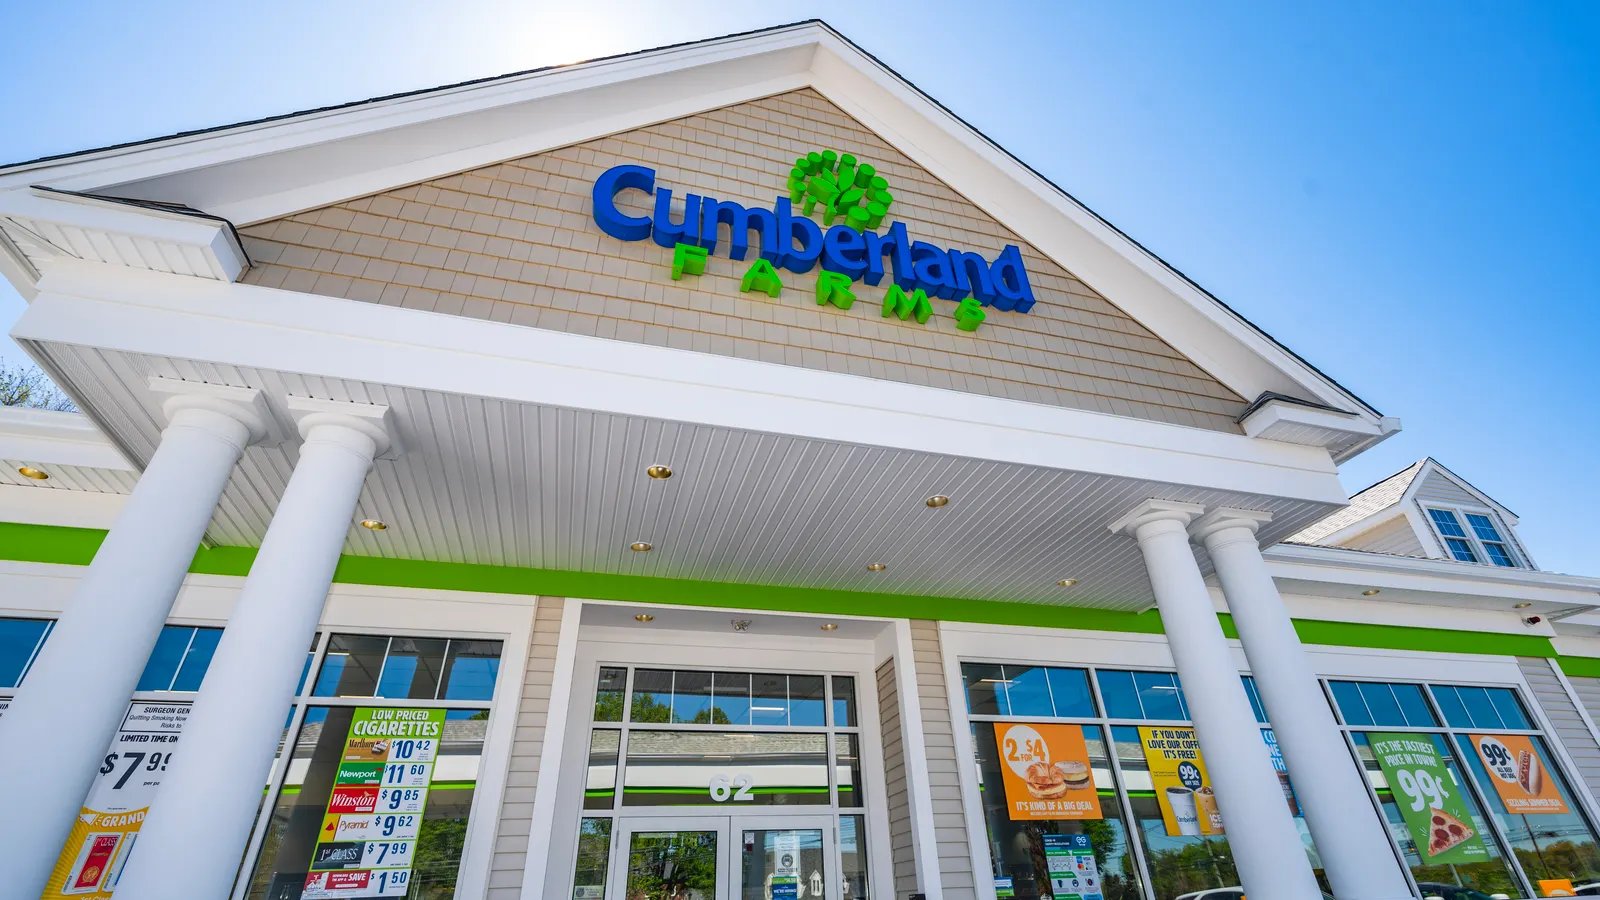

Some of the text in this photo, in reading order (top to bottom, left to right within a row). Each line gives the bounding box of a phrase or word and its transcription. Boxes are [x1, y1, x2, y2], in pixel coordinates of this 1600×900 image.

[592, 164, 1036, 314] Cumberland
[670, 242, 987, 332] FARMS
[144, 706, 176, 714] SURGEON
[371, 710, 429, 720] LOW PRICED
[353, 721, 440, 736] CIGARETTES
[1152, 731, 1196, 739] IF YOU DON'T
[1005, 738, 1020, 761] 2
[1020, 754, 1033, 762] FOR
[1148, 740, 1165, 749] LOVE
[1167, 740, 1181, 749] OUR
[1374, 740, 1434, 755] IT'S THE TASTIEST
[1163, 750, 1196, 759] IT'S FREE!
[1384, 754, 1406, 767] PRICE
[1403, 754, 1414, 764] IN
[709, 774, 754, 802] 62
[331, 793, 375, 807] Winston
[1016, 802, 1094, 811] IT'S KIND OF A BIG DEAL
[101, 811, 145, 827] GRAND
[339, 821, 369, 831] Pyramid
[331, 848, 358, 860] CLASS
[348, 873, 366, 881] SAVE
